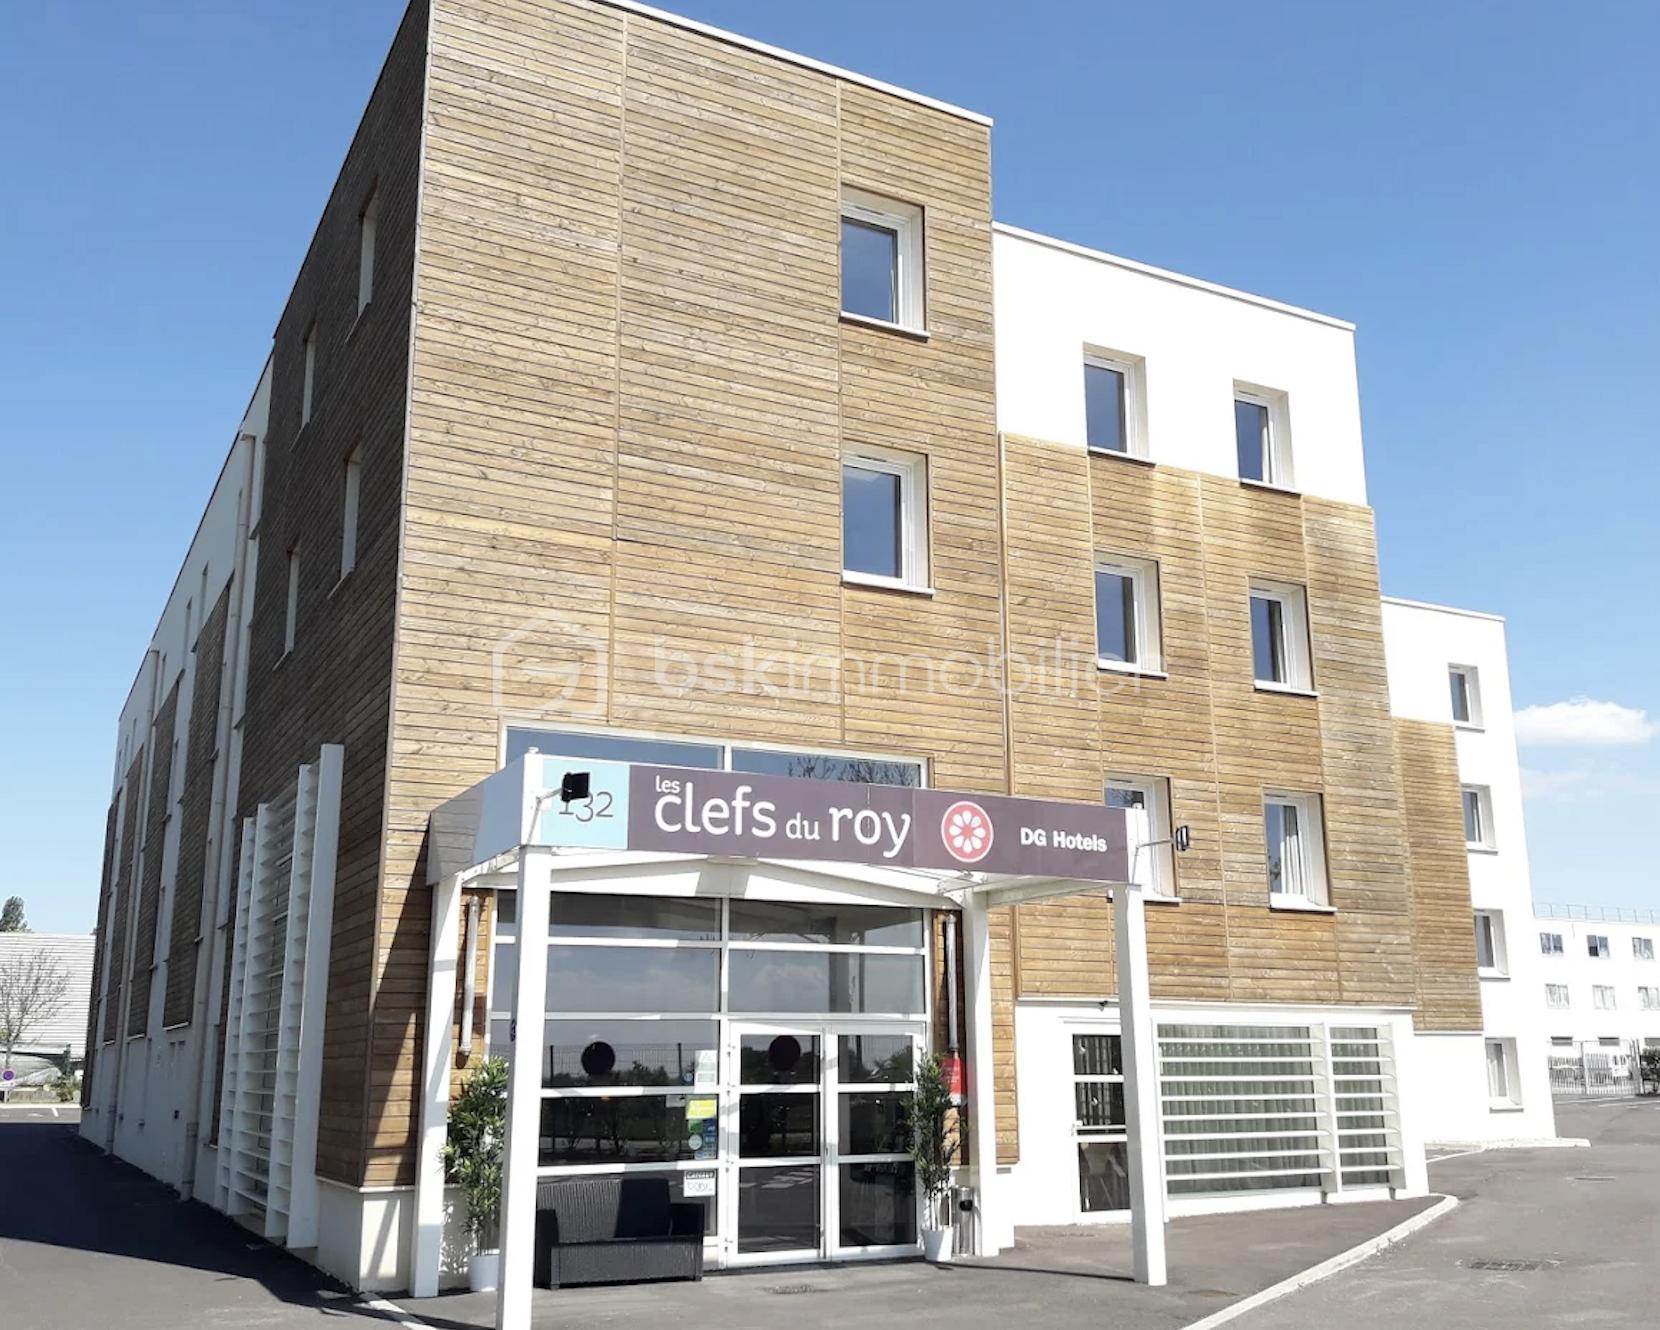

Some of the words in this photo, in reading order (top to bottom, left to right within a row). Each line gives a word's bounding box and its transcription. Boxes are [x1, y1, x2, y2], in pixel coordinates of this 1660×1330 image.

[656, 775, 681, 793] les
[655, 782, 777, 838] clefs
[785, 812, 820, 840] du
[828, 806, 912, 858] roy
[1020, 827, 1047, 846] DG
[1053, 830, 1107, 852] Hotels
